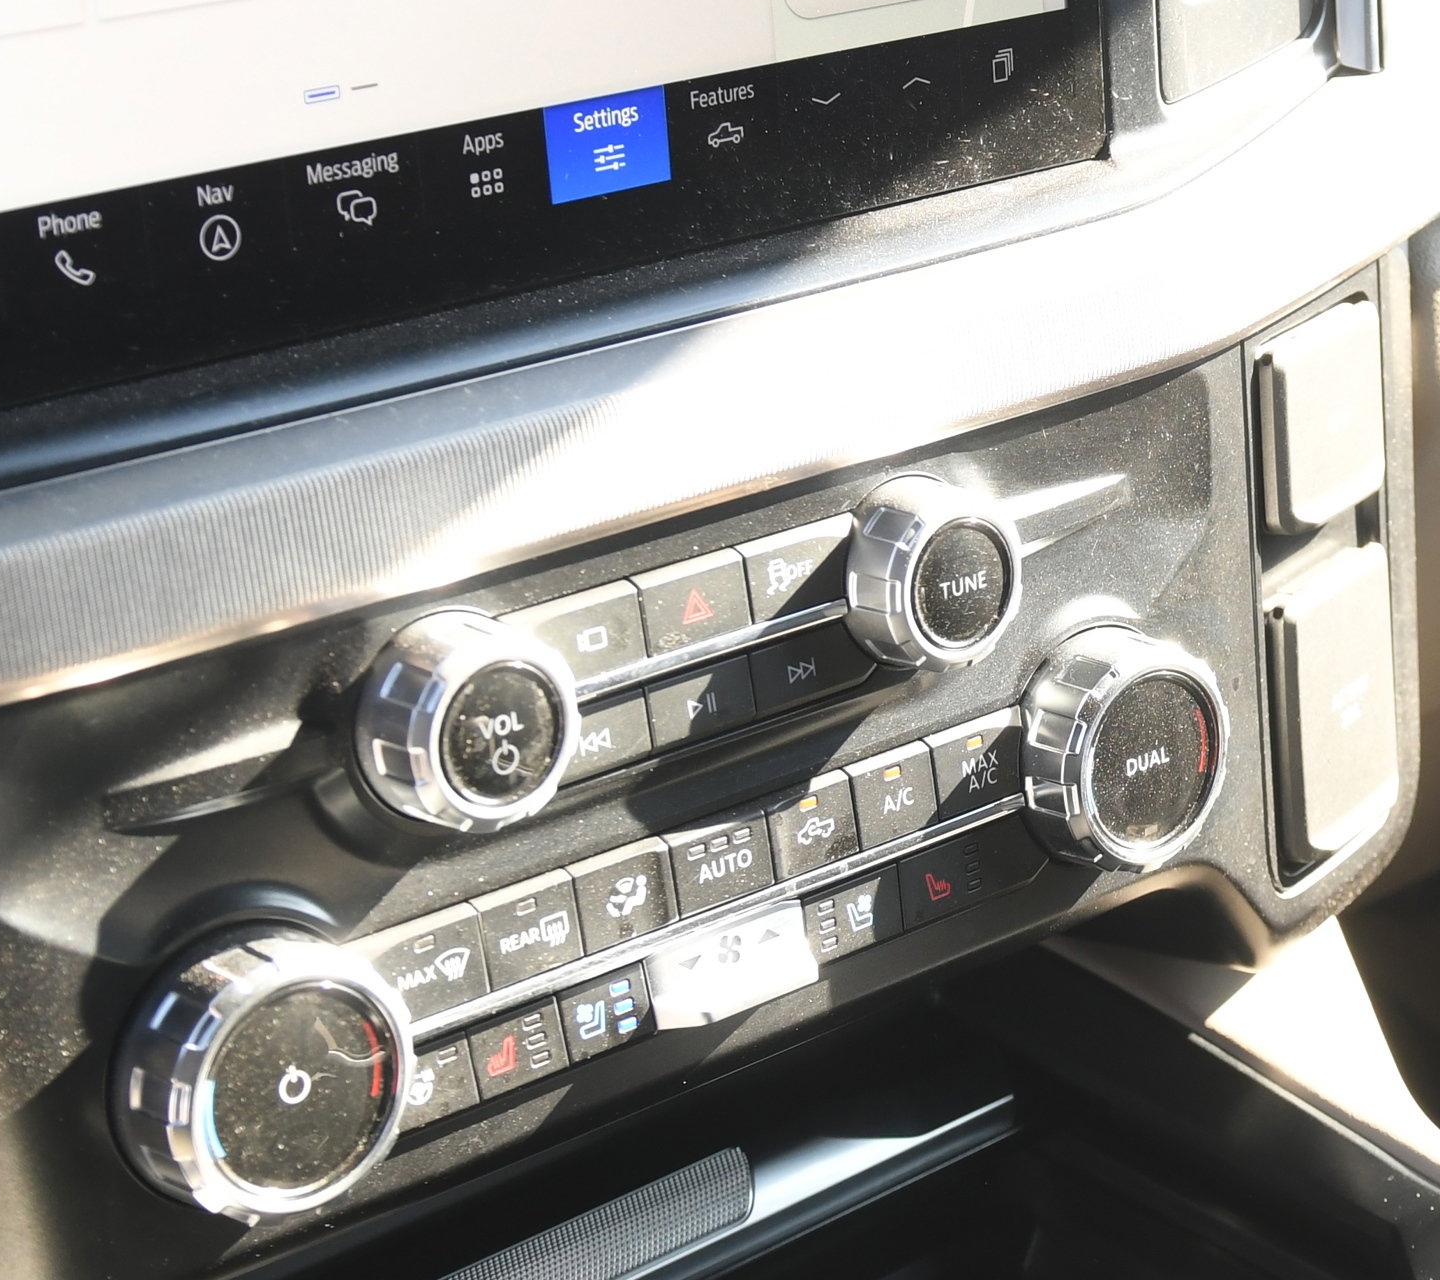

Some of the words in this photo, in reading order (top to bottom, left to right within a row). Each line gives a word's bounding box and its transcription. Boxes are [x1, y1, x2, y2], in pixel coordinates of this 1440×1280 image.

[690, 81, 755, 110] Features
[573, 101, 639, 135] Settings
[462, 128, 505, 156] Apps
[306, 151, 400, 186] Messaging
[197, 183, 234, 207] Nav
[38, 207, 102, 239] Phone
[786, 557, 814, 582] OFF
[940, 570, 987, 598] TUNE
[479, 710, 524, 741] VOL
[962, 749, 999, 778] MAX
[1126, 747, 1170, 777] DUAL
[968, 763, 1000, 794] A/C
[883, 786, 915, 814] A/C
[698, 849, 753, 884] AUTO
[499, 926, 542, 954] REAR
[397, 965, 437, 991] MAX
